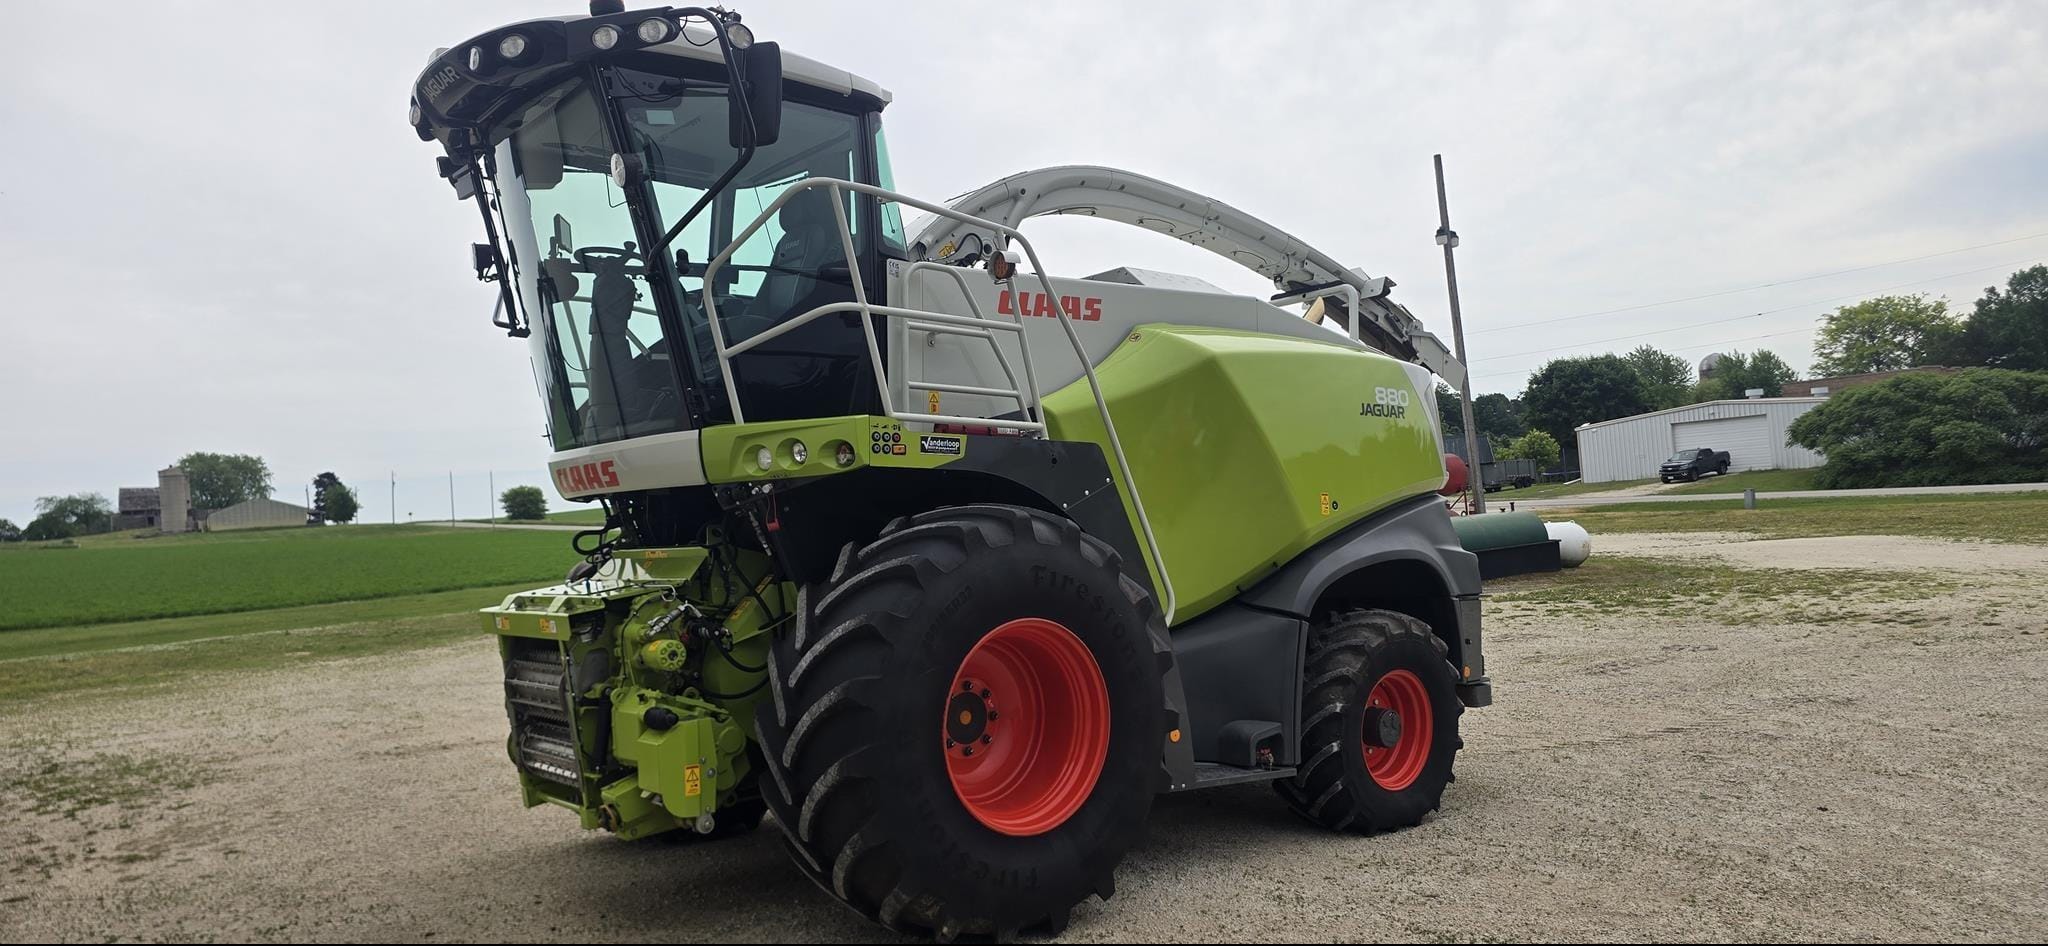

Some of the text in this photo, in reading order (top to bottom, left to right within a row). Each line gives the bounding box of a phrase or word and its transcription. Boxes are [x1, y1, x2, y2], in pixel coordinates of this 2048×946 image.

[421, 66, 460, 102] JAGUAR
[998, 290, 1102, 321] CLAAS
[1375, 386, 1409, 406] 880
[1360, 403, 1406, 419] JAGUAR
[921, 437, 960, 450] Vanderloop
[556, 460, 620, 493] CLAAS
